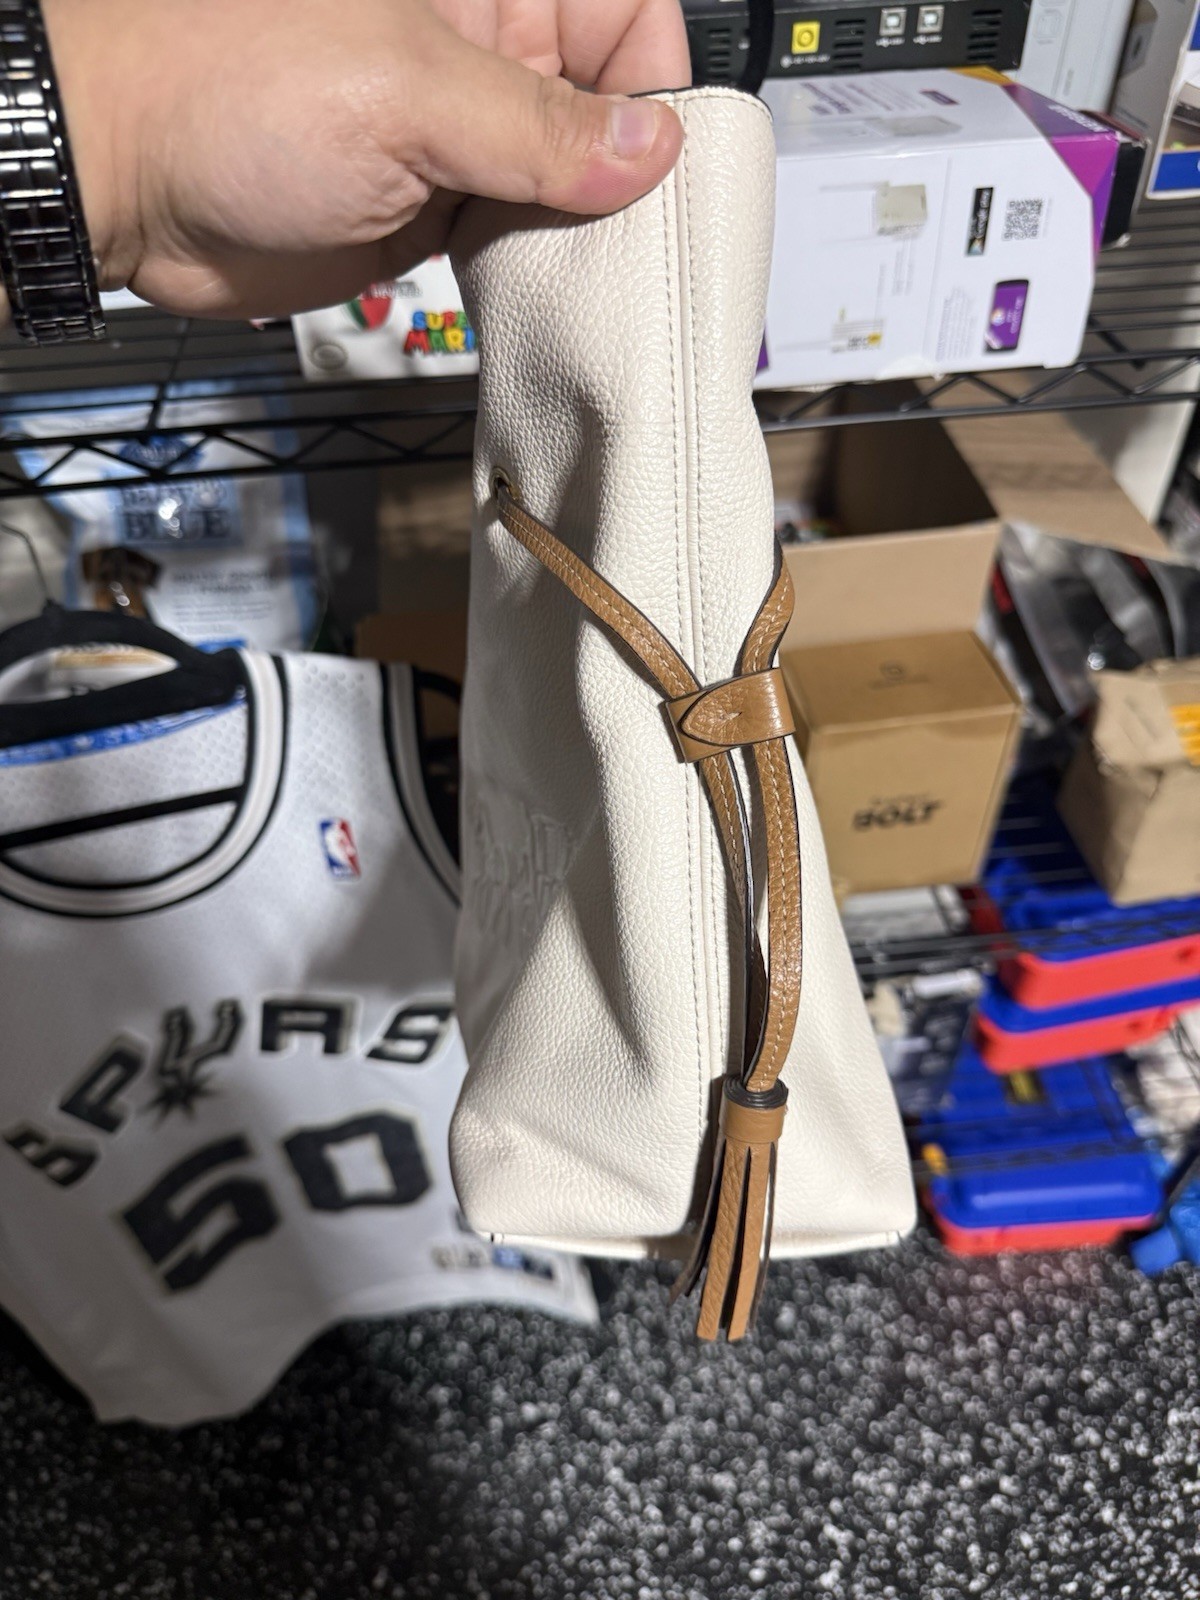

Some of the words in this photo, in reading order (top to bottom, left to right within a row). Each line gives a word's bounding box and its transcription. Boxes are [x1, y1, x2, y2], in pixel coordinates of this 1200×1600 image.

[412, 310, 468, 331] SUPE
[403, 327, 476, 354] MARI
[121, 1110, 434, 1293] 50
